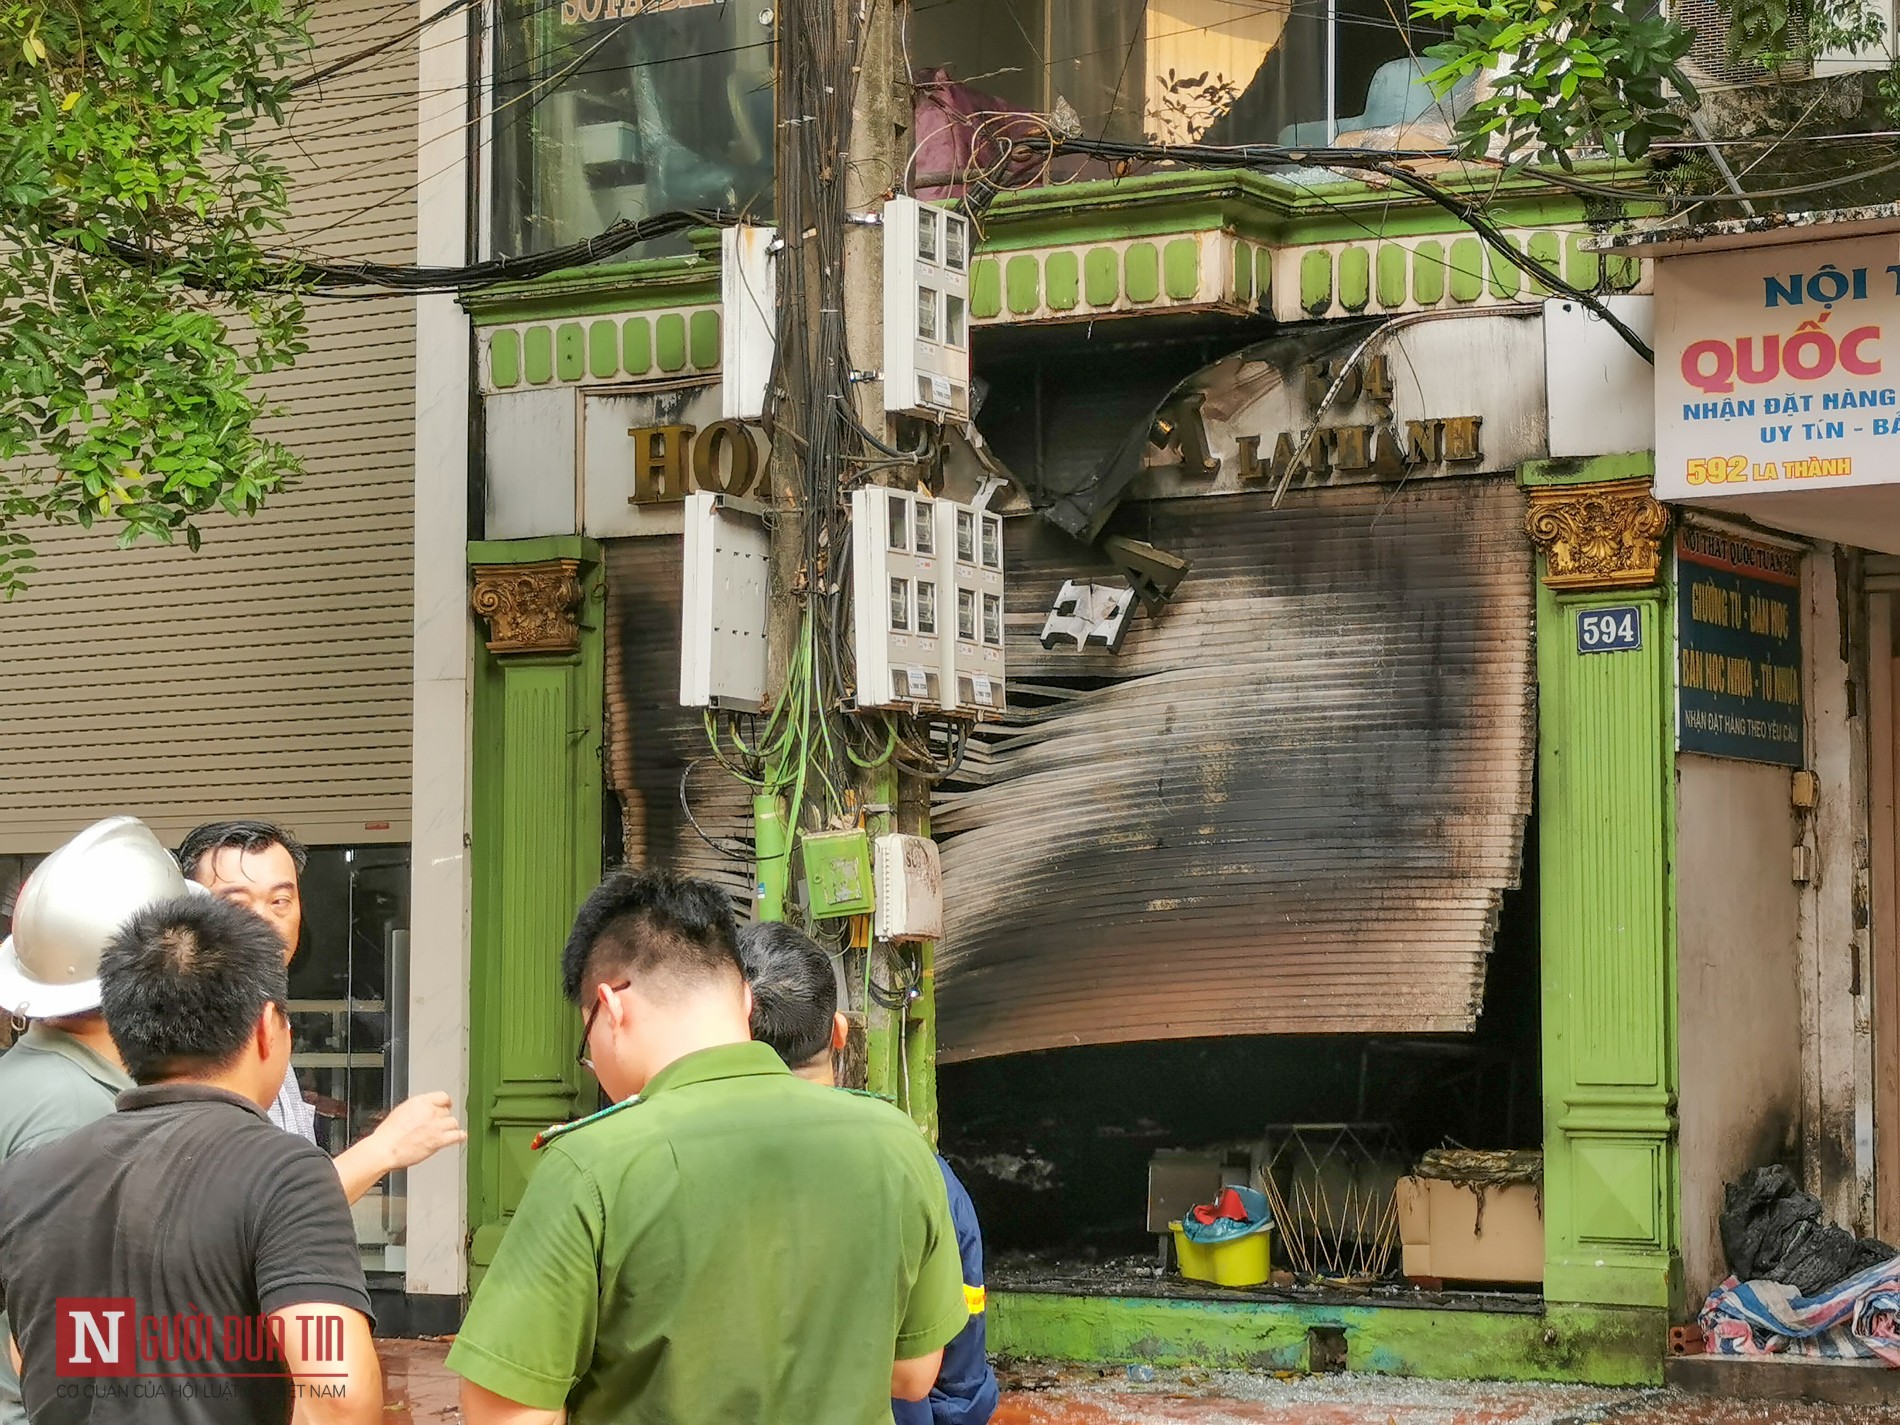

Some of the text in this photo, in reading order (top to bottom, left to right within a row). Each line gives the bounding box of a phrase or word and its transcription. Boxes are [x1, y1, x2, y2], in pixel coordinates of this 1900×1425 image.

[1763, 264, 1868, 309] NỘI
[1680, 312, 1882, 393] QUỐC
[1683, 388, 1896, 422] NHẬN ĐẶT HÀNG
[1760, 425, 1793, 443] UY
[1802, 419, 1845, 440] TÍN
[1686, 455, 1852, 485] 592 LA THÀNH
[1583, 613, 1634, 645] 594
